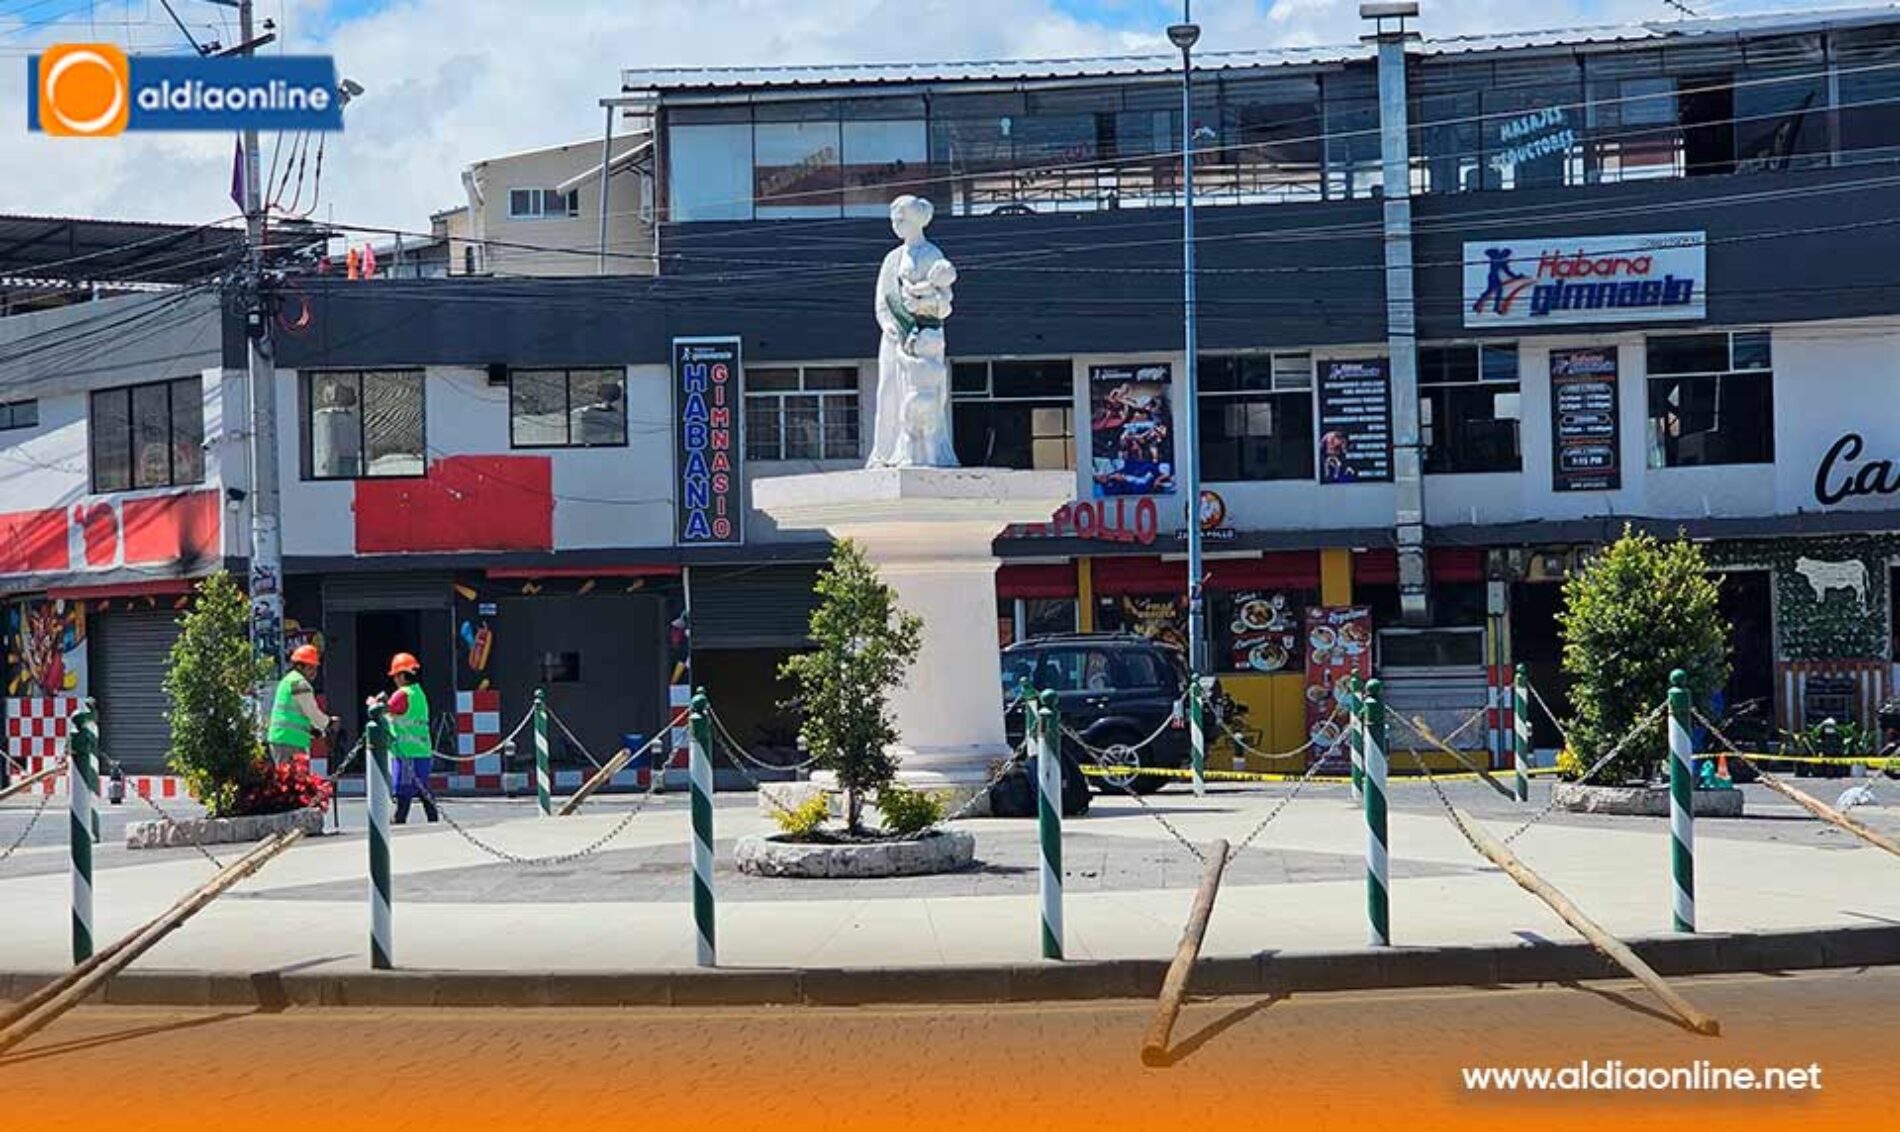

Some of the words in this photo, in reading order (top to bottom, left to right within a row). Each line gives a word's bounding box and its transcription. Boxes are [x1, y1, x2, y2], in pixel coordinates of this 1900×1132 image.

[1537, 249, 1652, 278] Habana
[684, 364, 711, 538] HABANA
[711, 364, 731, 538] GIMNASIO
[1815, 432, 1900, 505] Ca
[1053, 497, 1157, 545] POLLO
